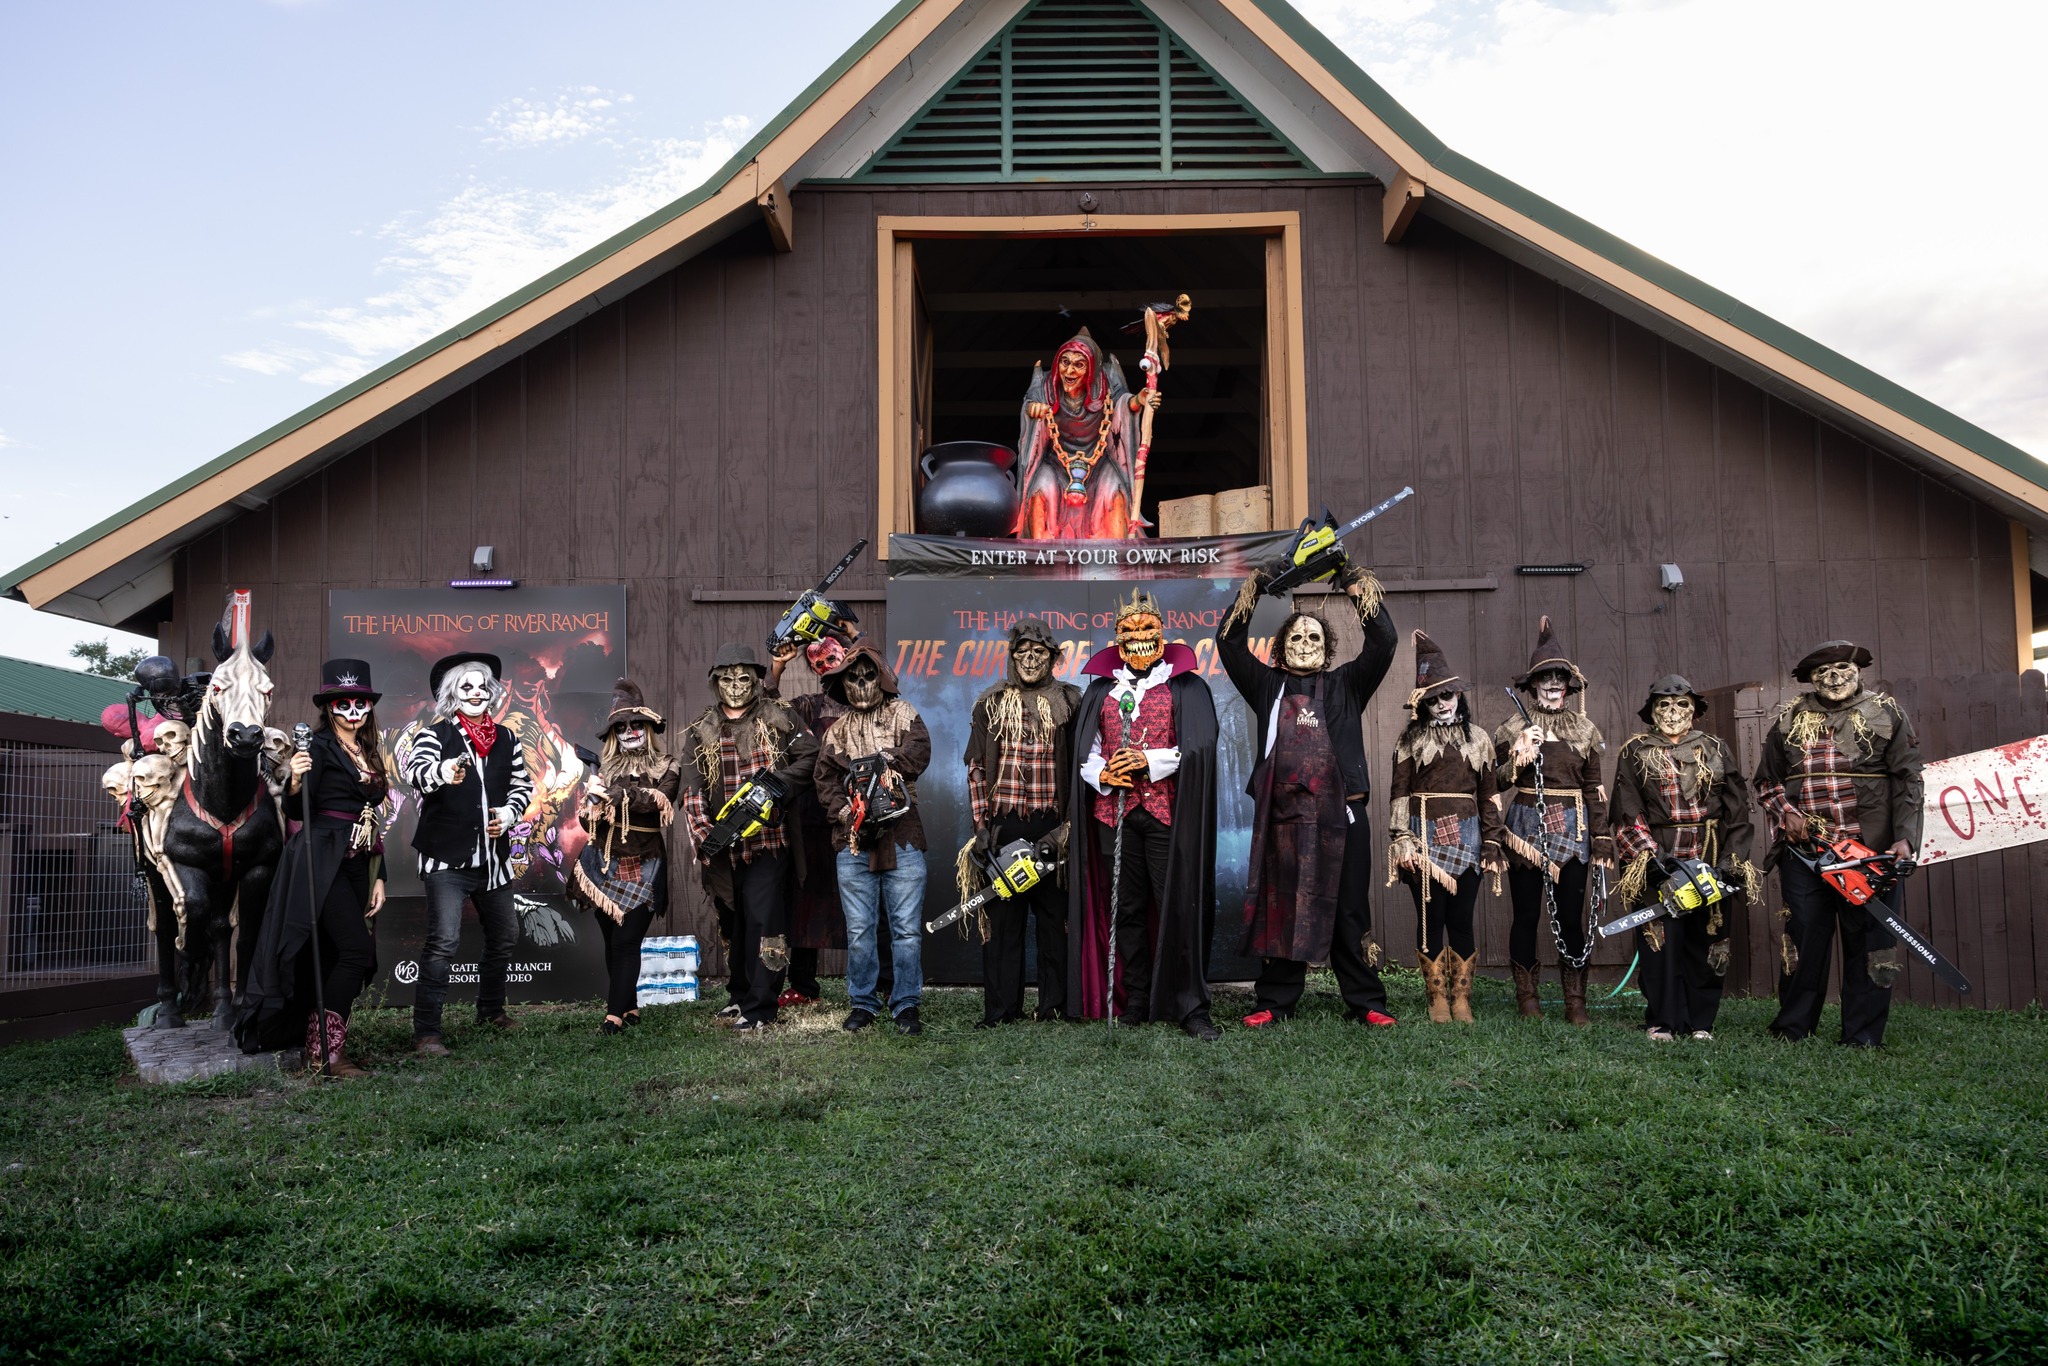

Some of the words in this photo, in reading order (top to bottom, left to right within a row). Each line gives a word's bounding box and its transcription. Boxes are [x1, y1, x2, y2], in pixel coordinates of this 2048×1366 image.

[1350, 510, 1376, 529] RYOBI
[971, 550, 1027, 565] ENTER
[1035, 550, 1057, 565] AT
[1065, 549, 1118, 565] YOUR
[1126, 549, 1171, 565] OWN
[1180, 548, 1220, 563] RISK
[826, 565, 844, 584] RYOBI
[236, 595, 247, 603] FIRE
[343, 615, 378, 635] THE
[382, 614, 473, 634] HAUNTING
[478, 614, 500, 630] OF
[953, 609, 990, 631] THE
[994, 610, 1088, 631] HATING
[1091, 611, 1114, 629] OF
[894, 639, 948, 679] THE
[952, 639, 1010, 680] CUR
[947, 910, 957, 921] 14"
[961, 894, 985, 913] RYOBI
[1618, 919, 1629, 929] 14"
[1632, 908, 1655, 923] RYOBI
[1886, 917, 1937, 965] PROFESSIONAL
[450, 963, 478, 972] GATE
[515, 962, 552, 971] RANCH
[448, 974, 480, 983] ESORT
